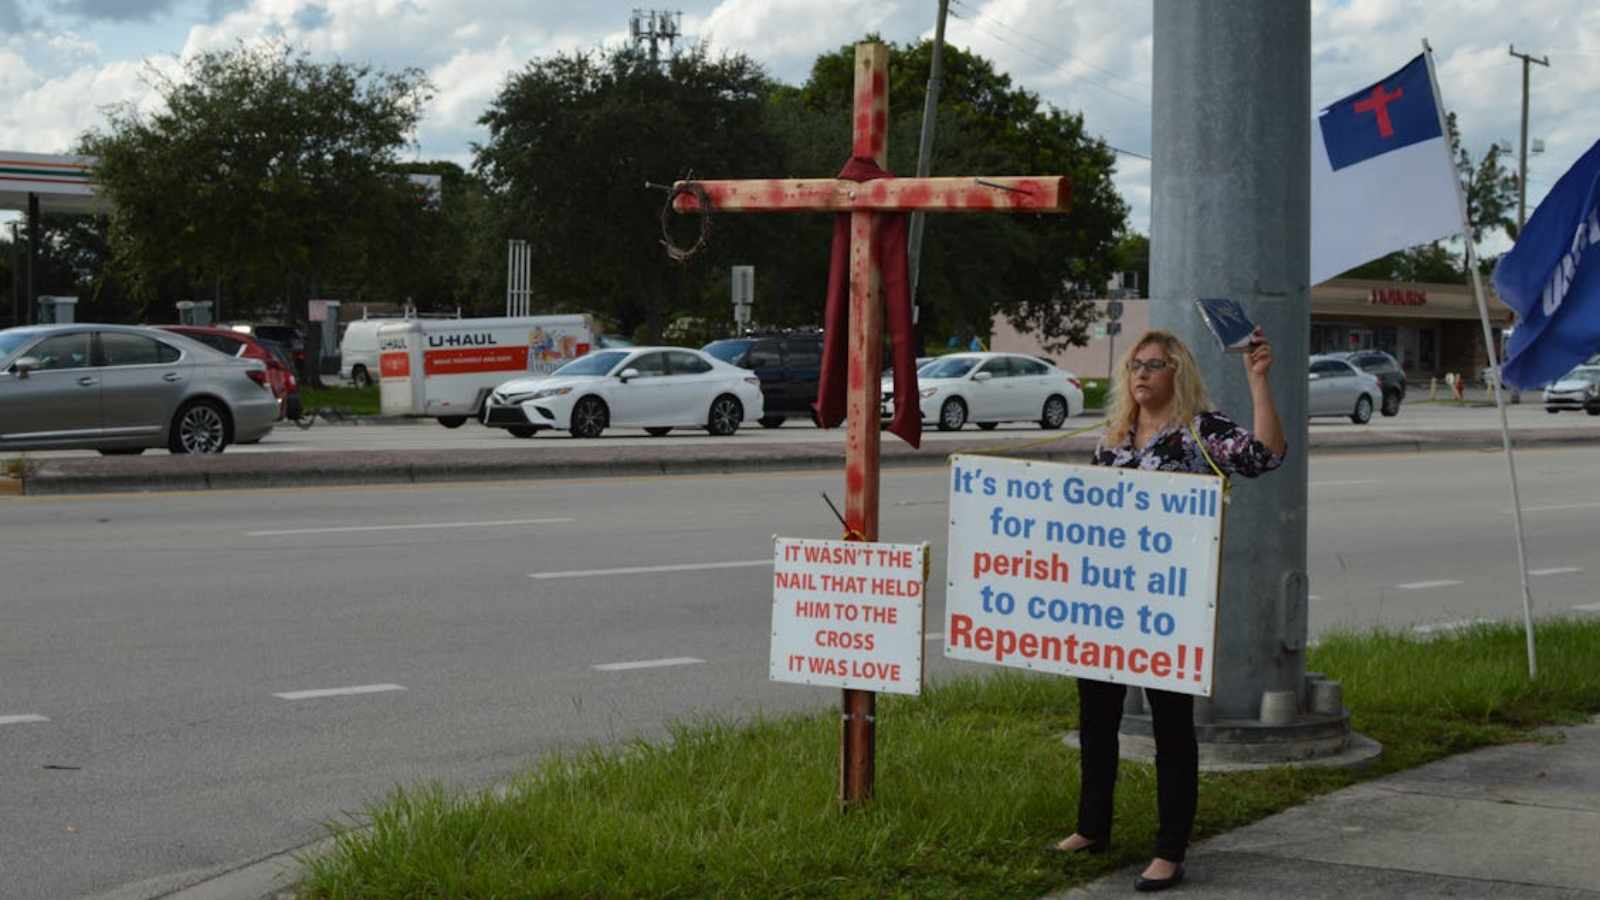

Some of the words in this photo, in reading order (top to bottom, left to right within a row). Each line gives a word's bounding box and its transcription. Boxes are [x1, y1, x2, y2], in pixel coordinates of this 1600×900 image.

[429, 334, 497, 347] U-HAUL
[954, 465, 997, 496] It's
[1007, 479, 1053, 502] not
[1062, 476, 1150, 511] God's
[1161, 490, 1217, 516] will
[991, 505, 1036, 538] for
[1045, 520, 1126, 549] none
[1138, 527, 1173, 554] to
[785, 545, 800, 562] IT
[805, 547, 873, 565] WASN'T
[878, 550, 912, 568] THE
[775, 572, 816, 590] NAIL
[821, 575, 867, 593] THAT
[872, 578, 920, 597] HELD
[974, 552, 1070, 582] perish
[1081, 556, 1136, 591] but
[1147, 565, 1187, 597] all
[796, 600, 829, 619] HIM
[834, 604, 857, 620] TO
[862, 605, 897, 623] THE
[980, 584, 1015, 615] to
[1027, 595, 1124, 631] come
[1138, 606, 1176, 637] to
[815, 630, 874, 650] CROSS
[950, 612, 1205, 683] Repentance!!
[788, 655, 804, 672] IT
[808, 657, 847, 676] WAS
[853, 661, 900, 681] LOVE
